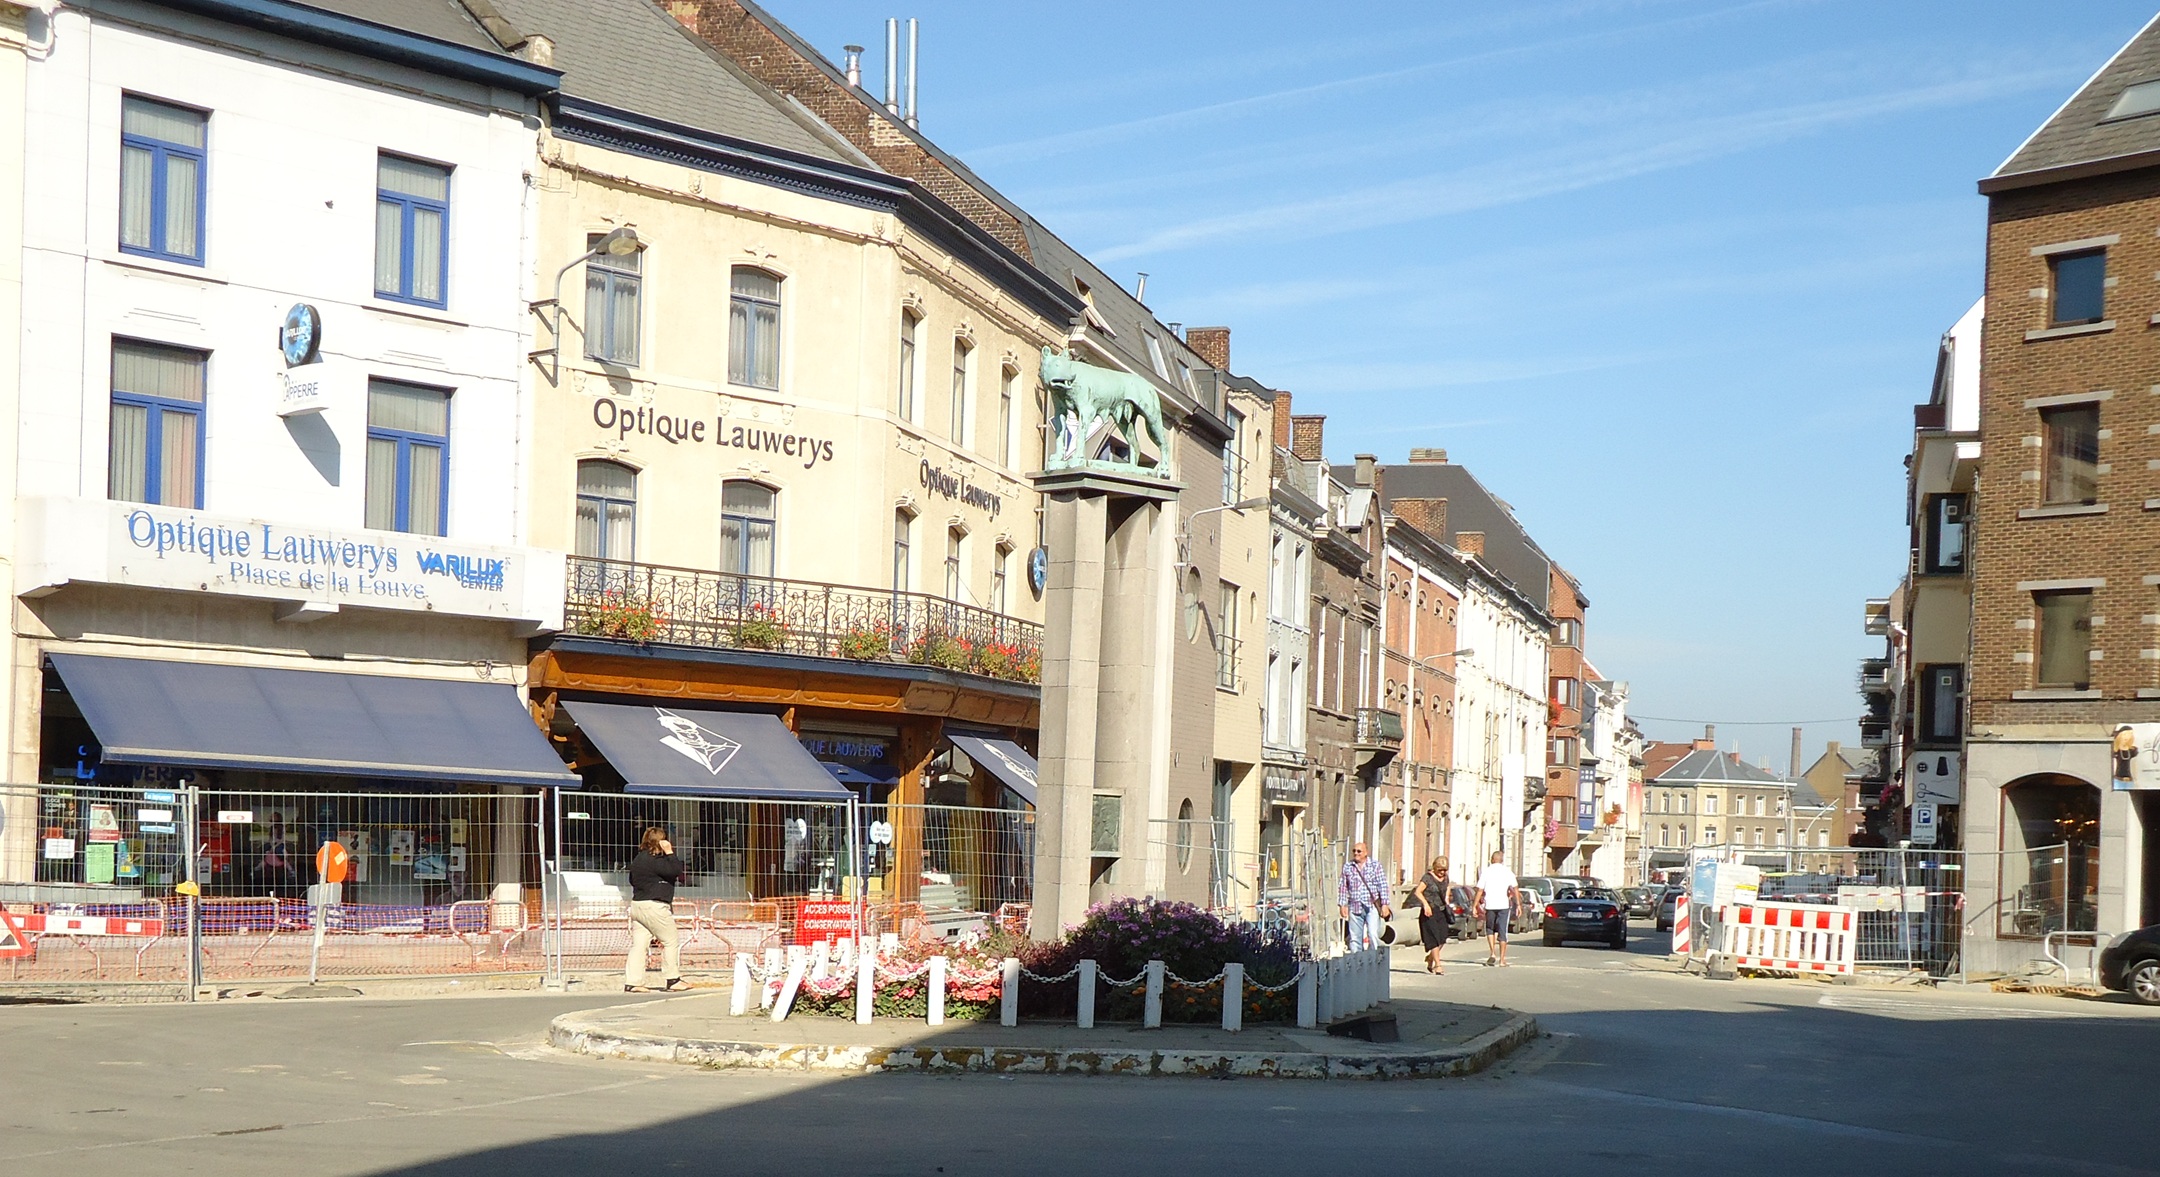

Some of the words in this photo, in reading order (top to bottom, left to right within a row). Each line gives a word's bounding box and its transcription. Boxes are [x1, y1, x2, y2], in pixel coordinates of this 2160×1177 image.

[593, 398, 705, 444] Optique
[716, 416, 833, 469] Lauwerys
[920, 459, 959, 501] Optique
[960, 476, 1001, 522] Lauwerys
[128, 510, 250, 563] Optique
[261, 524, 398, 577] Lauwerys
[416, 551, 504, 579] VARILUX
[230, 561, 291, 587] Place
[299, 569, 325, 591] de
[332, 571, 350, 593] la
[358, 575, 425, 599] Louve
[459, 573, 504, 592] CENTER
[828, 741, 884, 758] LAUWERYS
[828, 904, 862, 915] POSSIBL
[803, 919, 860, 930] CONSERVATOIE
